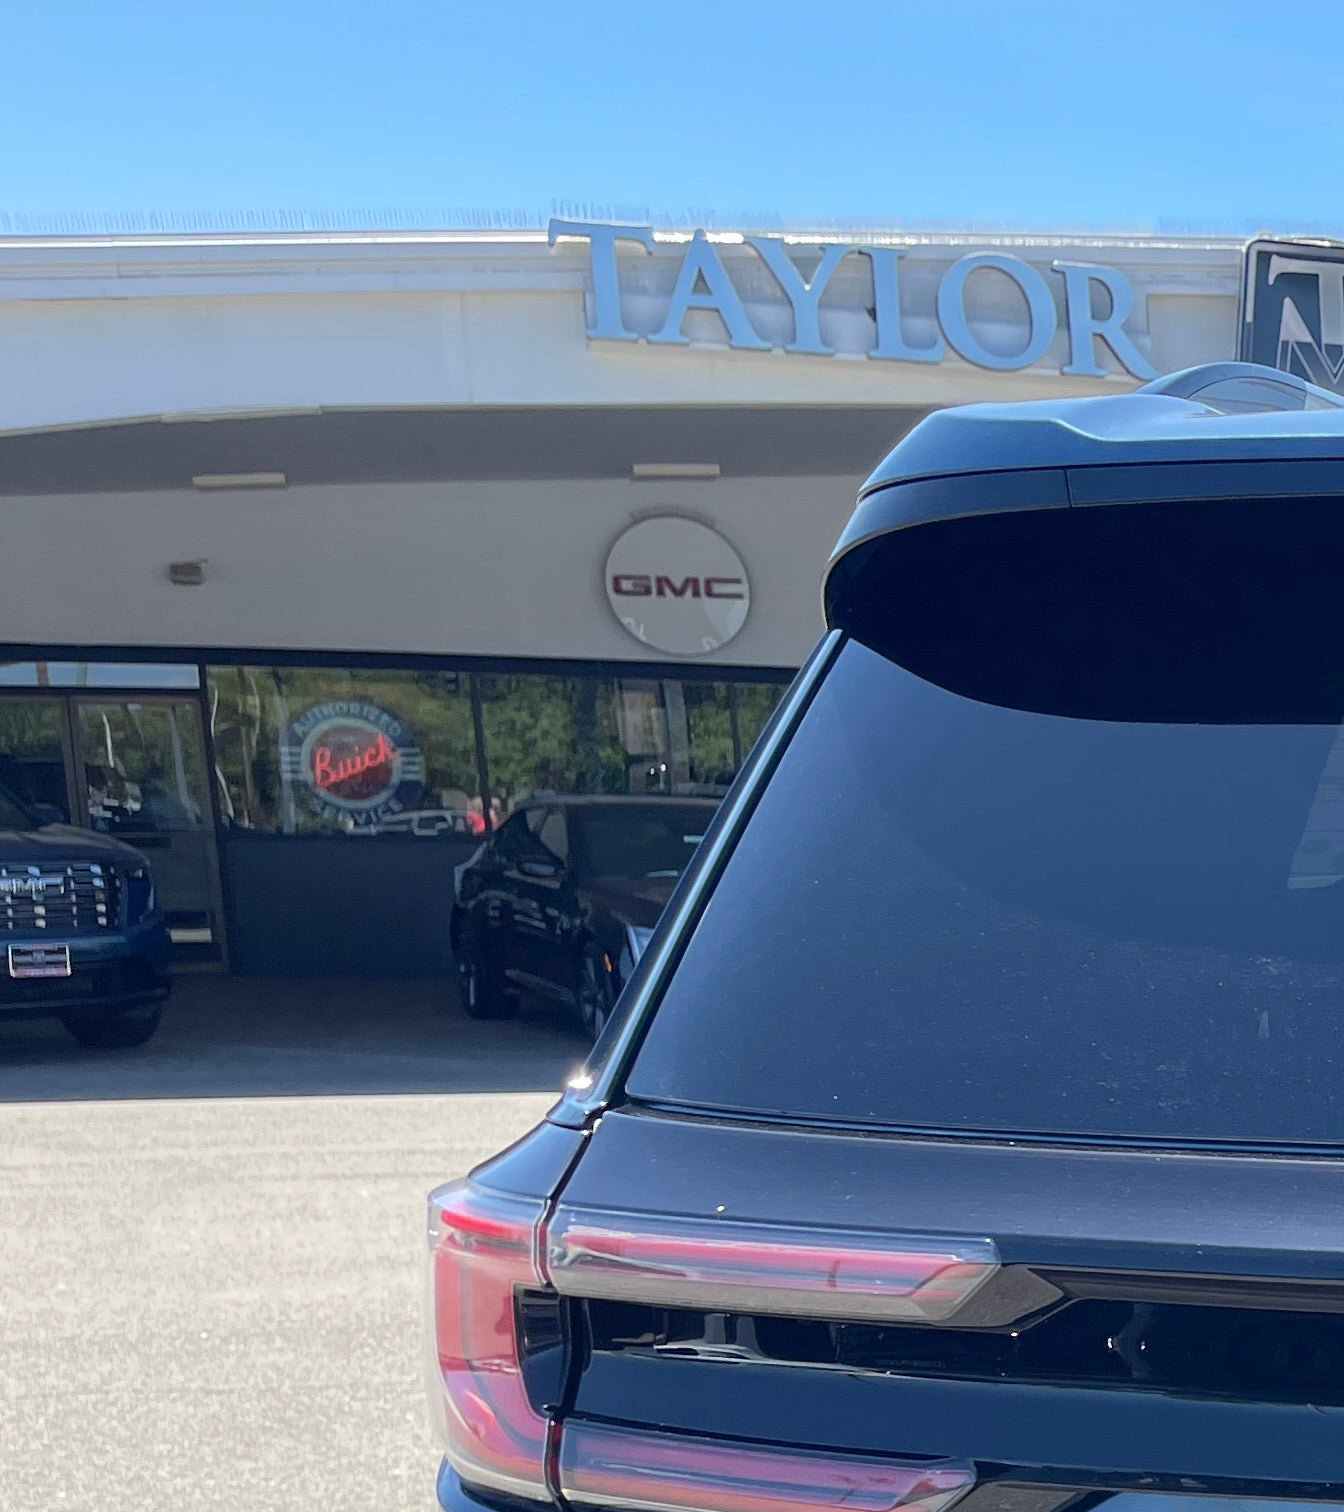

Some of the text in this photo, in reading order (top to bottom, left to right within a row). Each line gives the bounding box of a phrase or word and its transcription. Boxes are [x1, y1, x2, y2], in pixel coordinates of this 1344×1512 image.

[548, 218, 1162, 382] TAYLOR
[611, 573, 745, 600] GMC
[315, 732, 398, 788] Buick
